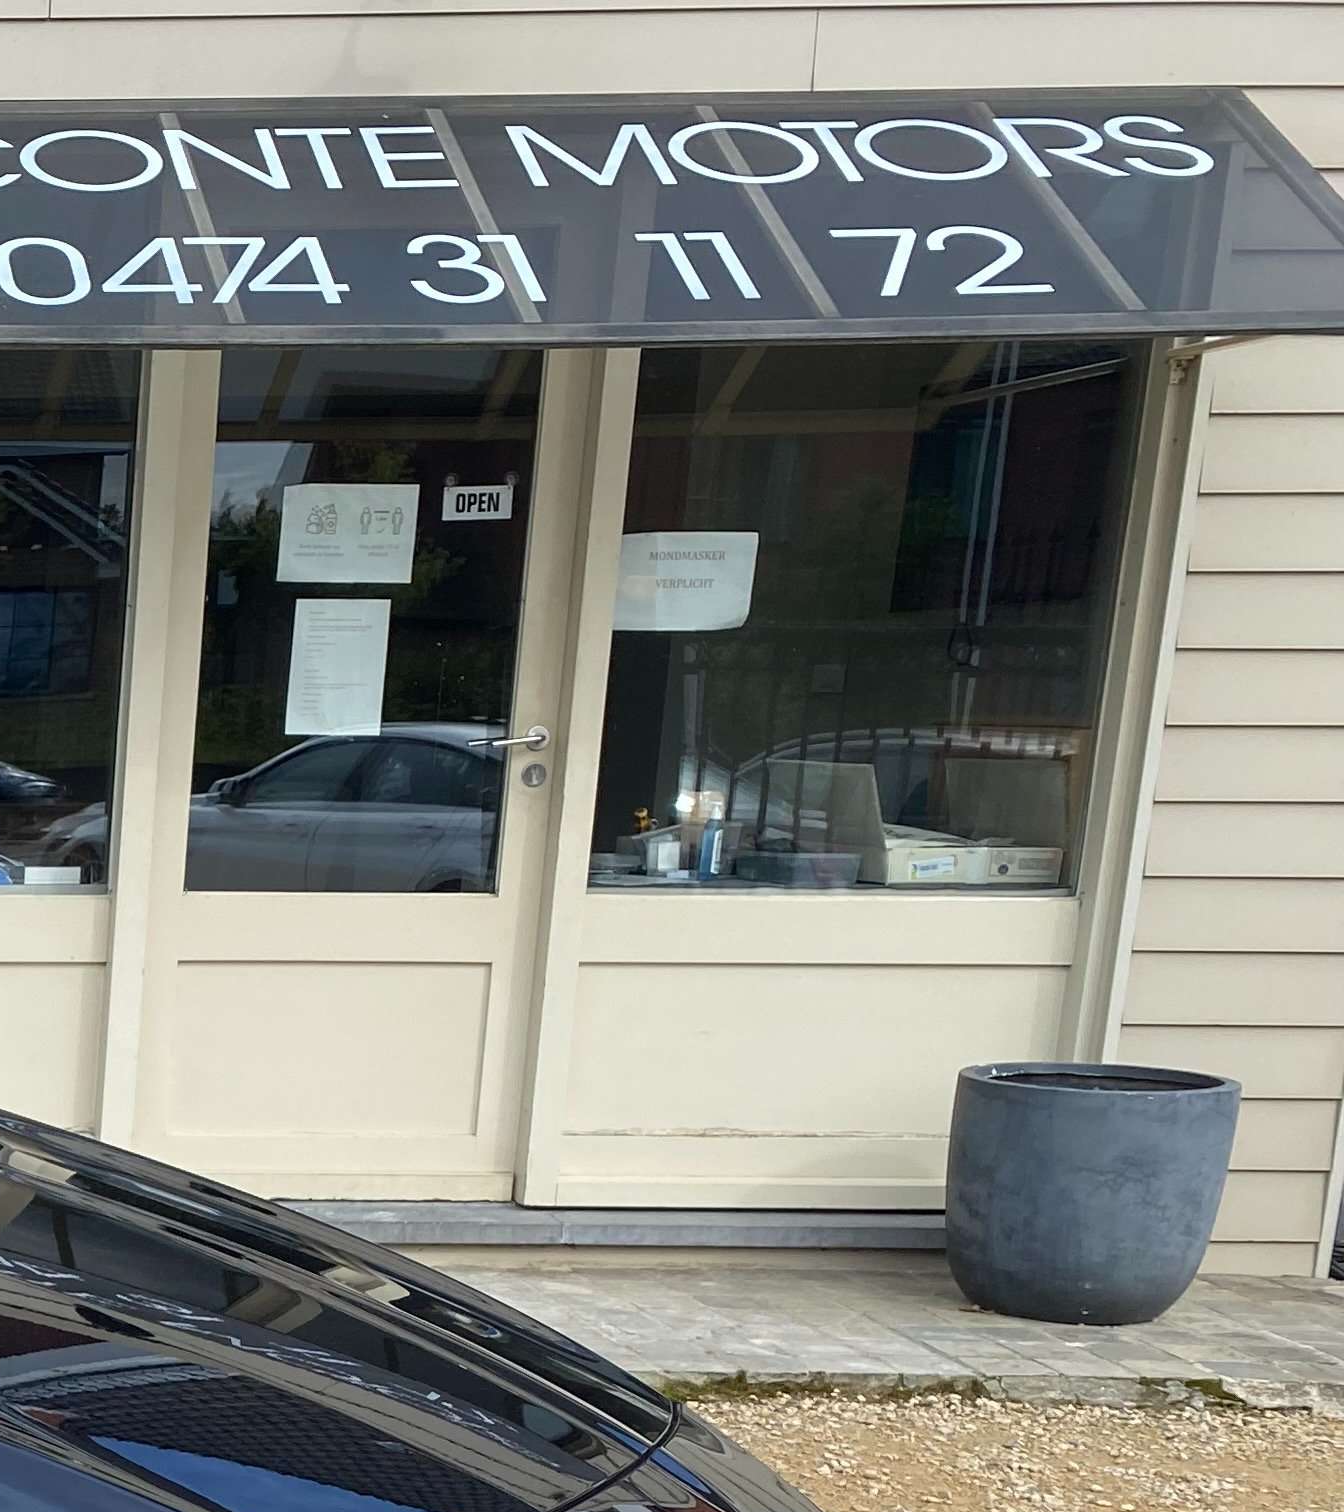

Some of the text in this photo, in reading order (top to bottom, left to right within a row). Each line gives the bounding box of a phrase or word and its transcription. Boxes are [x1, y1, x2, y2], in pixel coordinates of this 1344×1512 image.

[505, 116, 1214, 187] MOTORS
[406, 234, 547, 304] 31
[634, 231, 761, 300] 11
[829, 226, 1055, 297] 72
[455, 492, 500, 514] OPEN
[649, 551, 726, 562] MONDMASKER
[655, 578, 715, 589] VERPLICHT
